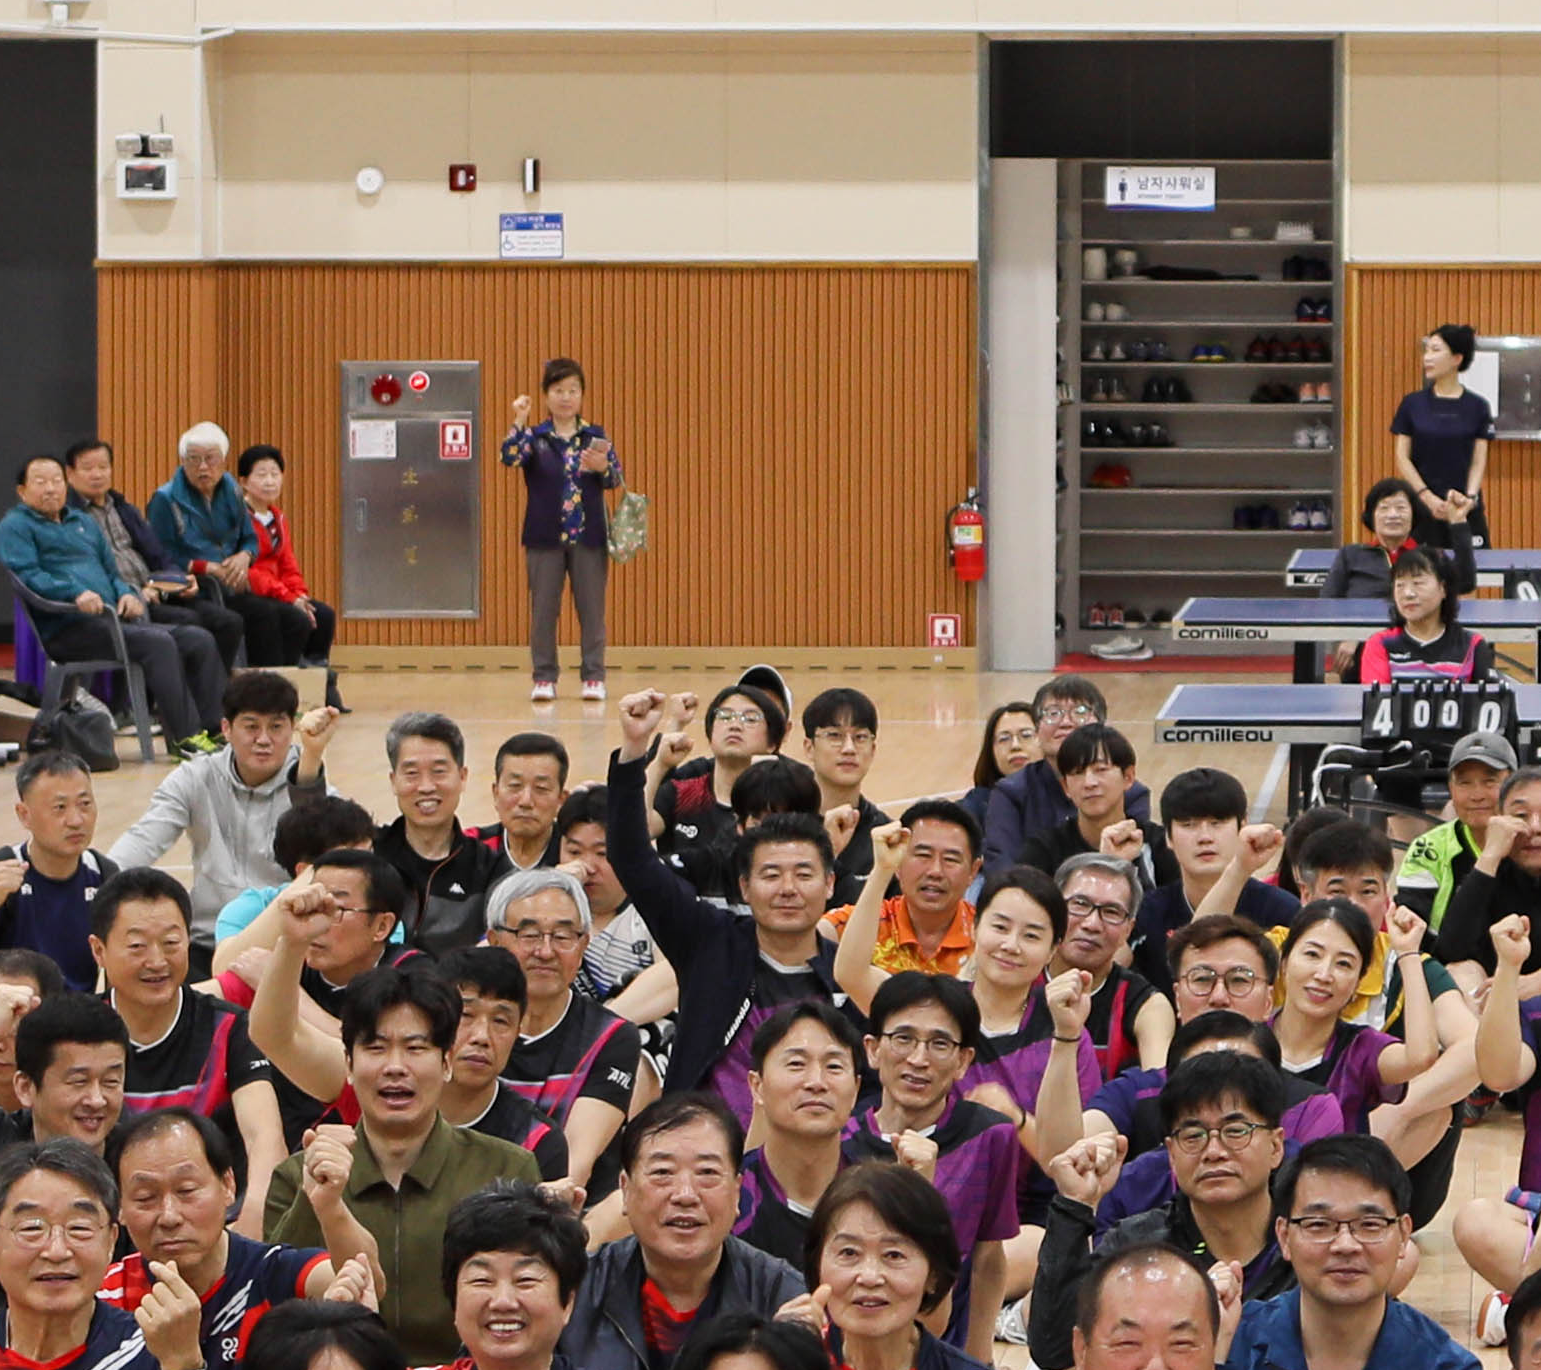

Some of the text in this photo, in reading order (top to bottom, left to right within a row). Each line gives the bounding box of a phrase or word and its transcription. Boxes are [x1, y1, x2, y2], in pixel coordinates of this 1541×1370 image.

[1178, 628, 1269, 639] cornilleau
[1372, 699, 1394, 736] 4
[1414, 700, 1430, 728] 0
[1163, 727, 1273, 743] cornilleau
